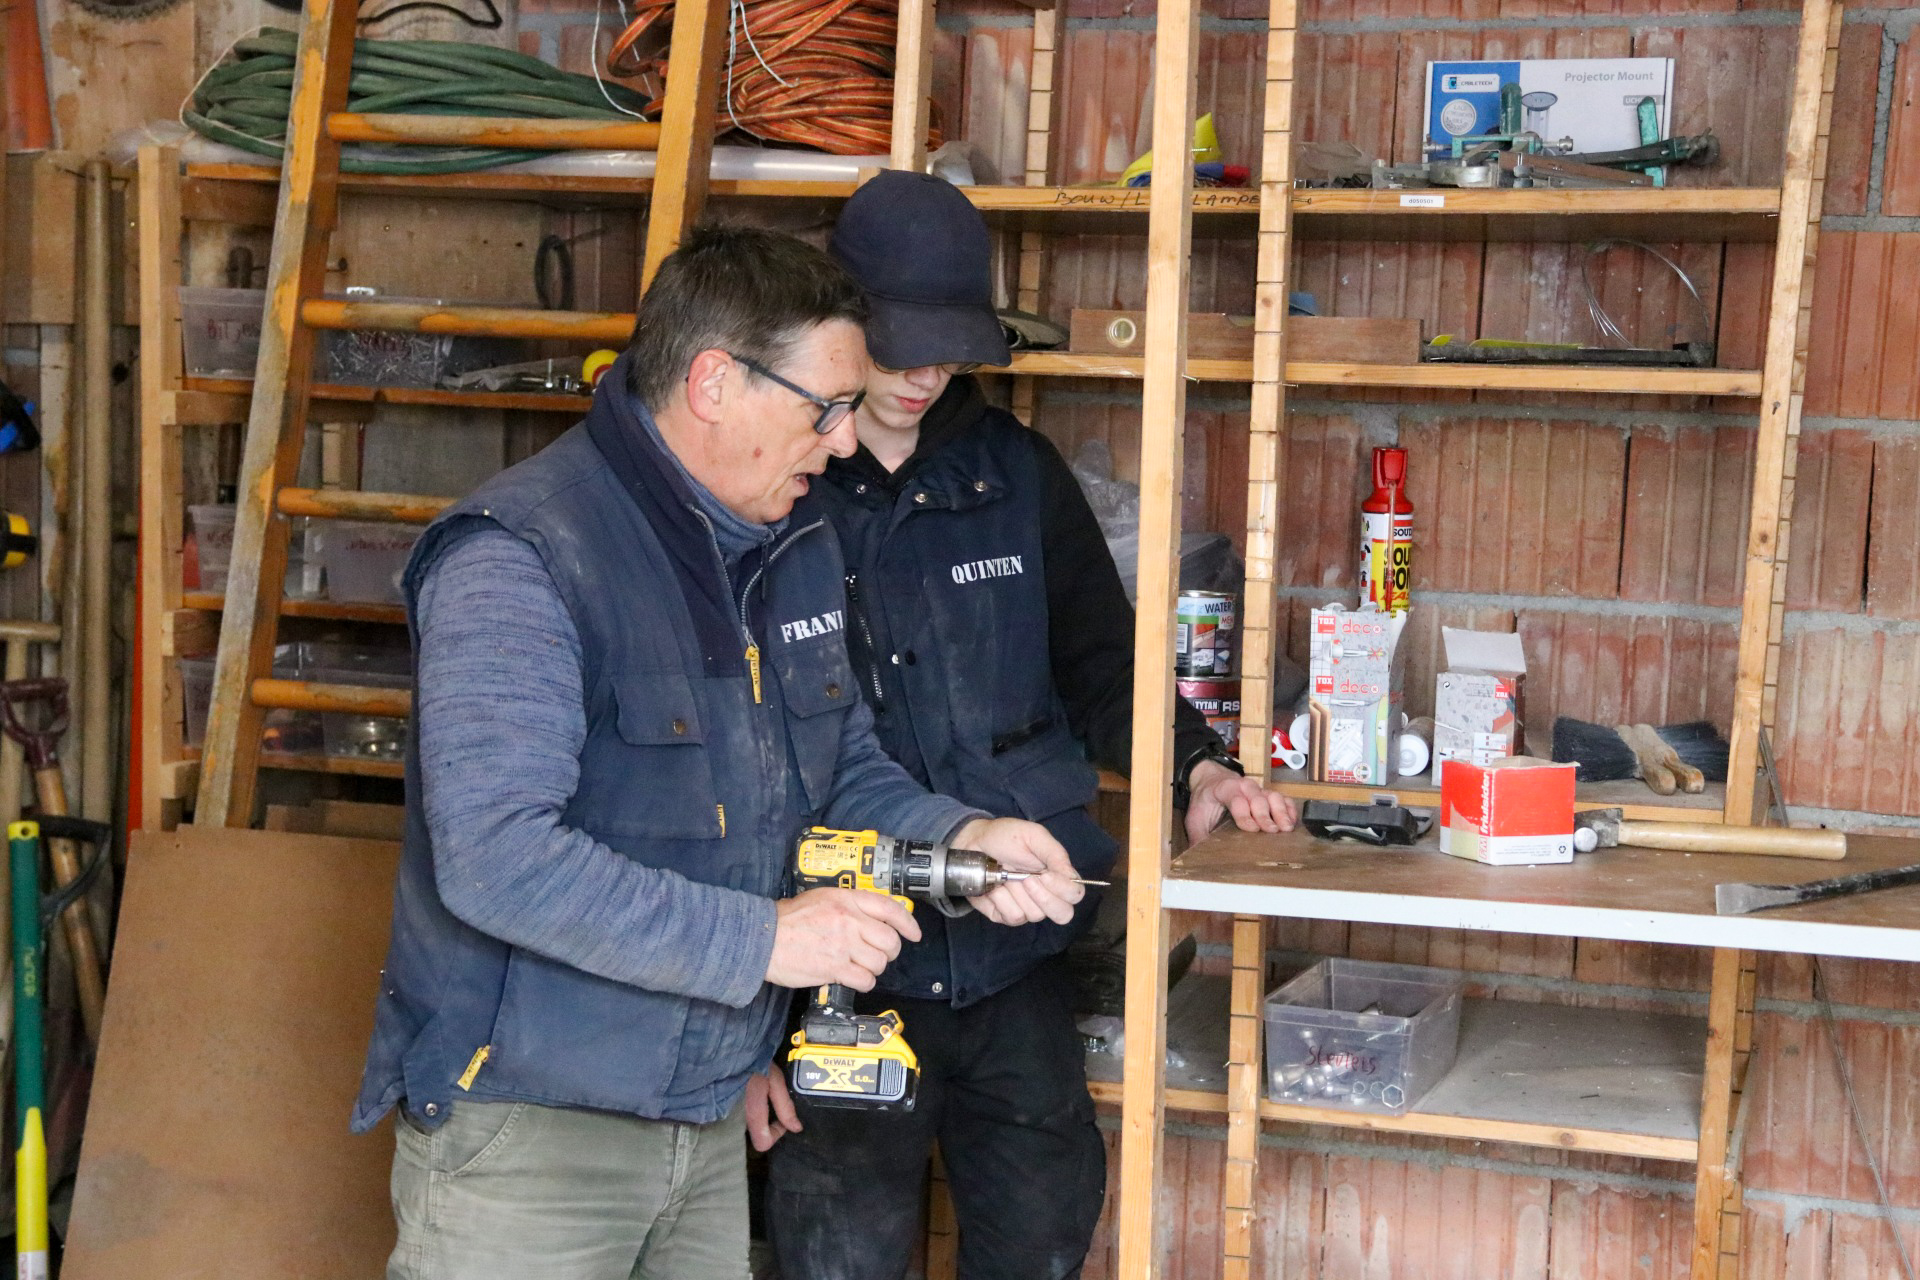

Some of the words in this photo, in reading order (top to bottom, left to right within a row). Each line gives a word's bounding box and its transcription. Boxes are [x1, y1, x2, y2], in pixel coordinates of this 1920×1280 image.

[1564, 72, 1615, 83] Projector
[1617, 71, 1654, 81] Mount
[951, 555, 1024, 585] QUINTEN
[1195, 701, 1218, 710] TYTAN
[823, 1058, 856, 1066] DEWALT
[805, 1072, 821, 1080] 18V
